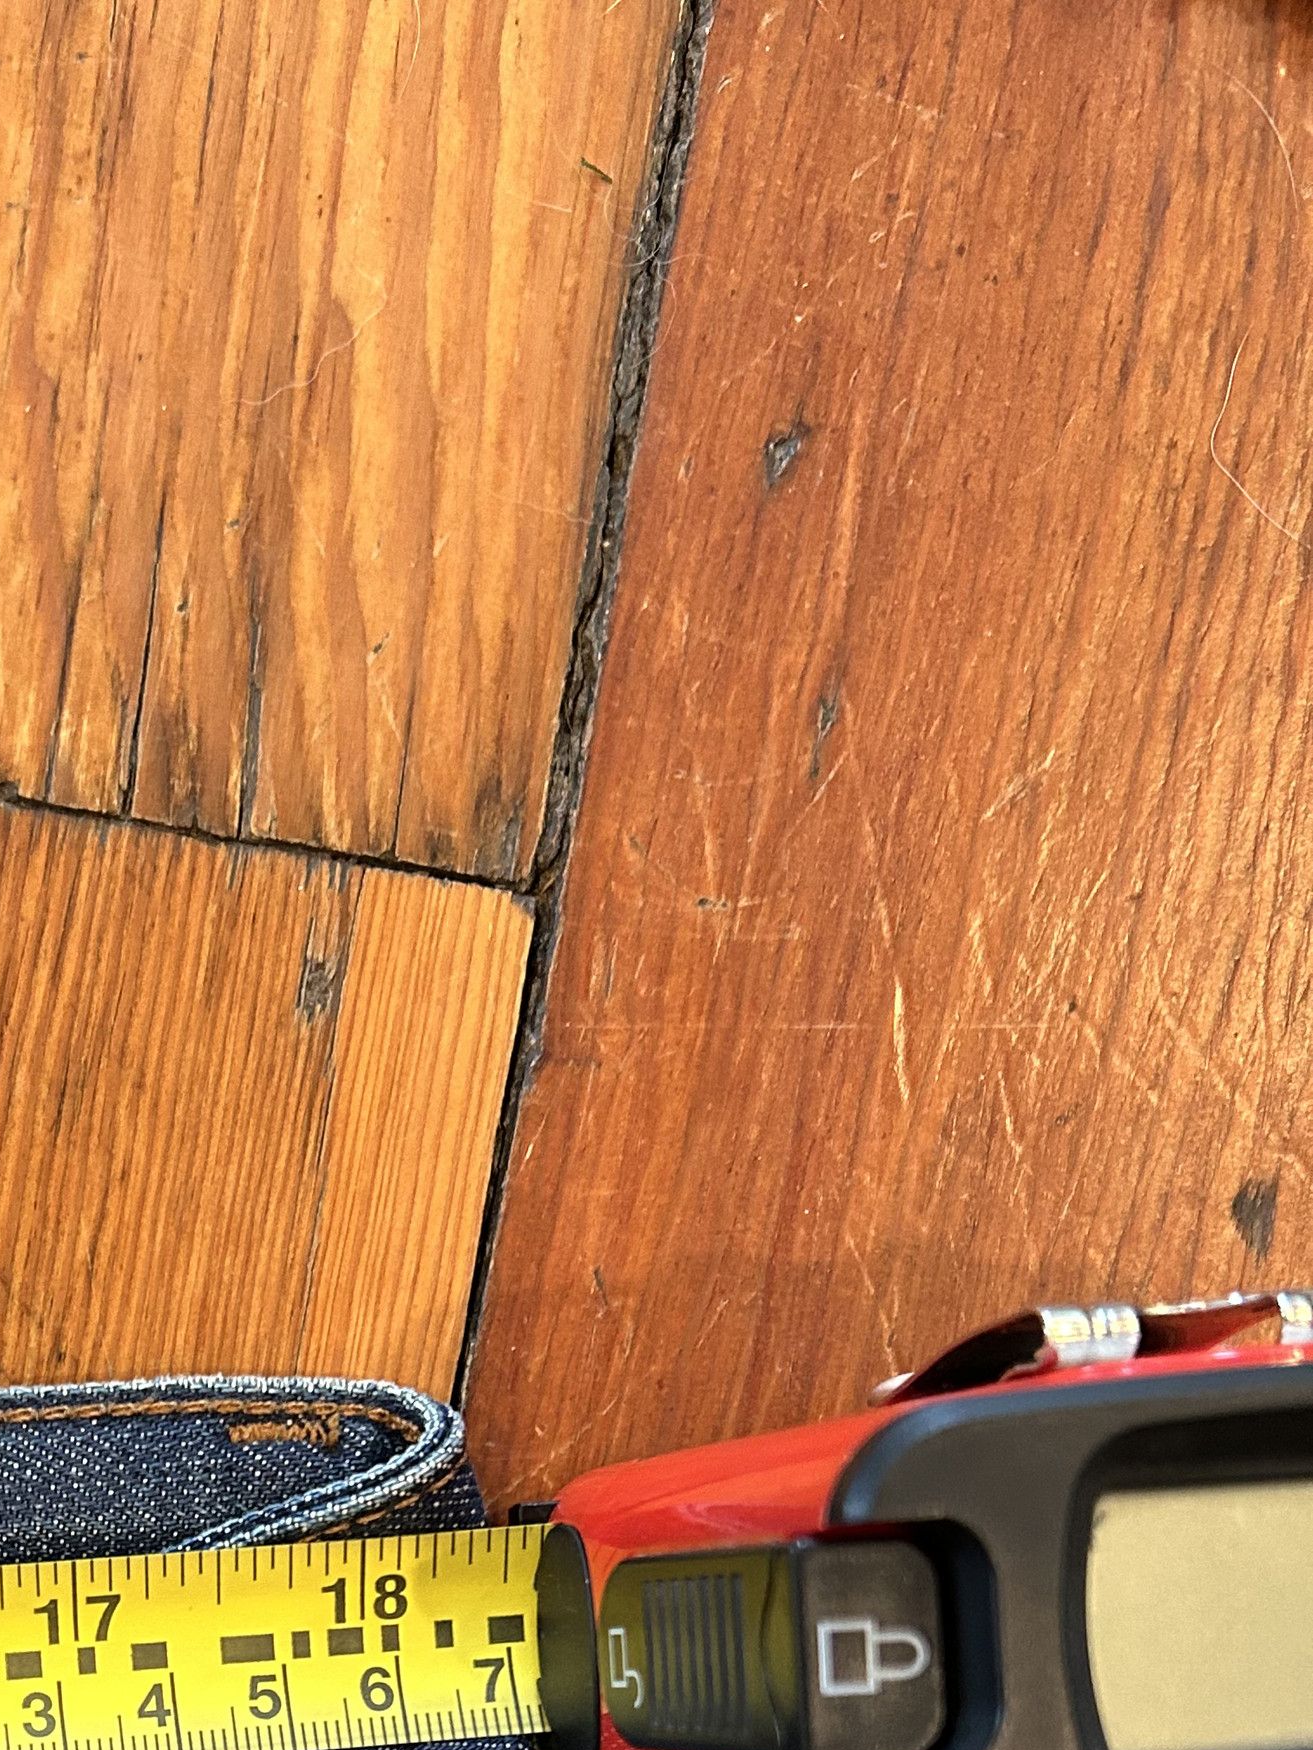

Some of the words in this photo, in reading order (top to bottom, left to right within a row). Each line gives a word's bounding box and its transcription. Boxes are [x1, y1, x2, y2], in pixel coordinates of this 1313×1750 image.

[35, 1594, 121, 1645] 17
[322, 1574, 407, 1624] 18
[21, 1692, 56, 1738] 3
[137, 1683, 171, 1728] 4
[248, 1674, 282, 1720] 5
[360, 1667, 394, 1711] 6
[473, 1657, 506, 1702] 7
